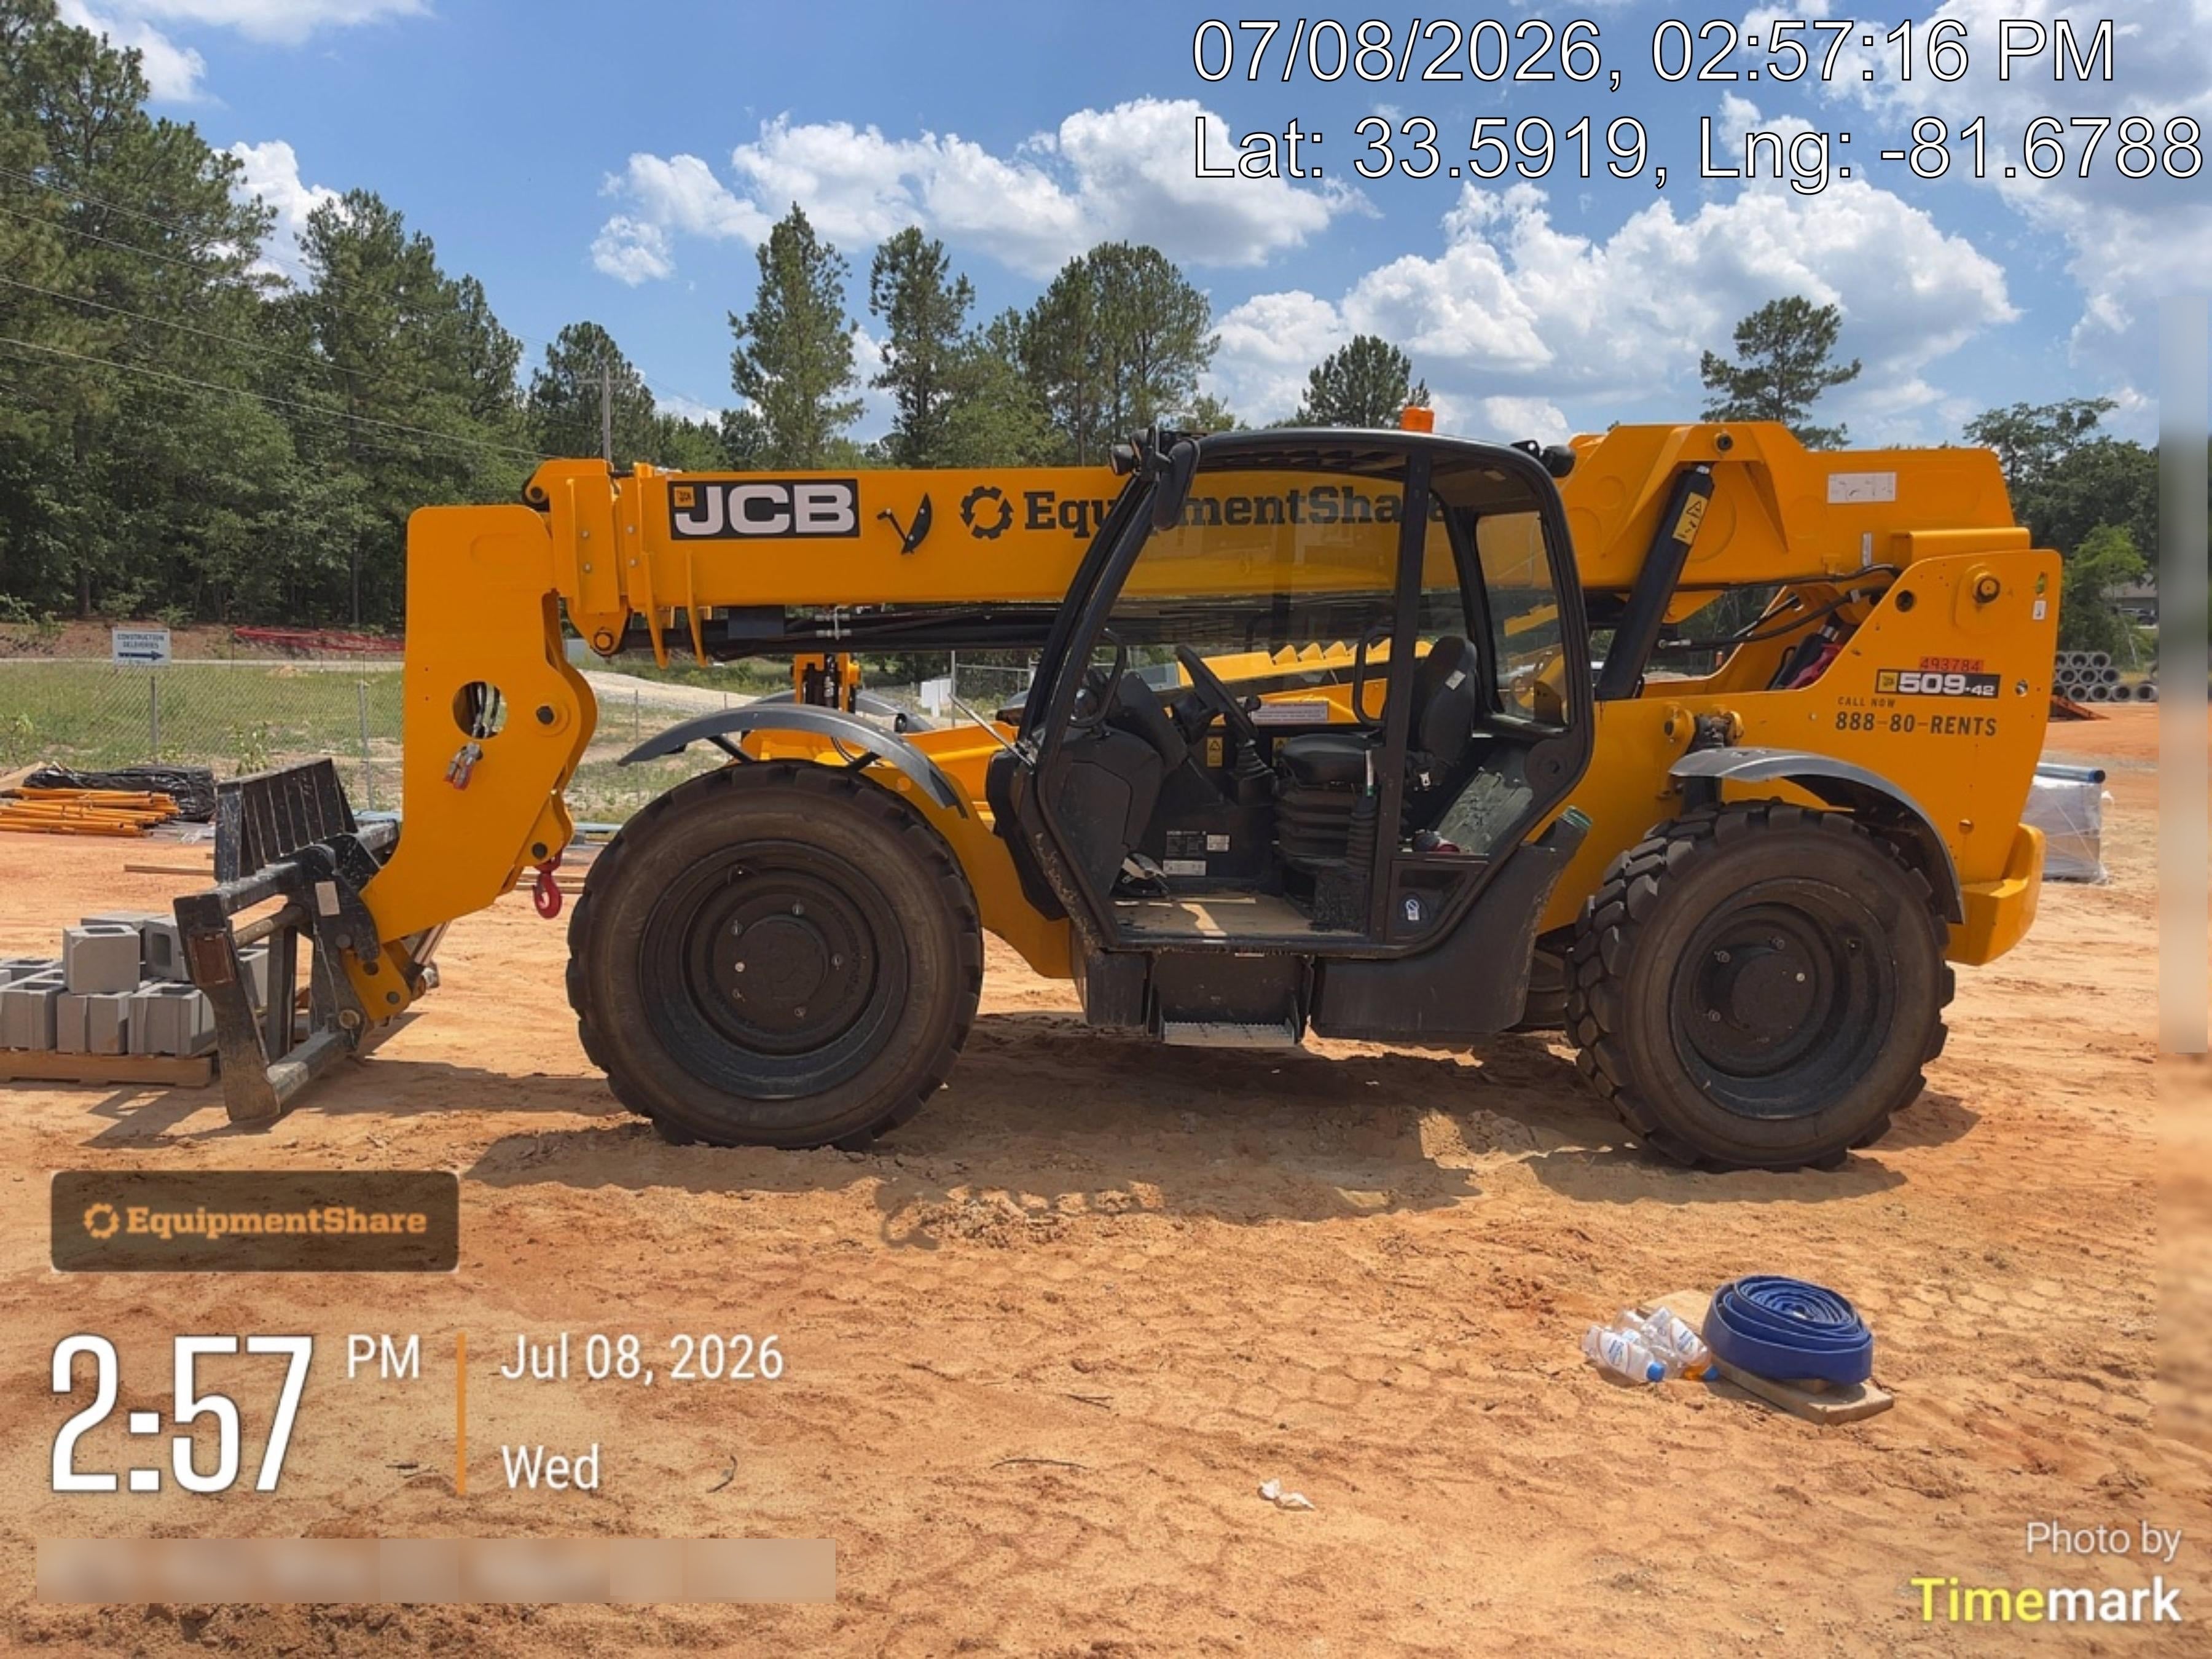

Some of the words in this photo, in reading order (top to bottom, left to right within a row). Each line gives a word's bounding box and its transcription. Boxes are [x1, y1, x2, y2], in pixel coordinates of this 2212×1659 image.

[675, 484, 855, 535] JCB
[1920, 657, 1982, 672] 493784
[1838, 697, 1865, 707] CALL
[1870, 698, 1896, 708] NOW
[1835, 711, 1997, 737] 888-80-RENTS
